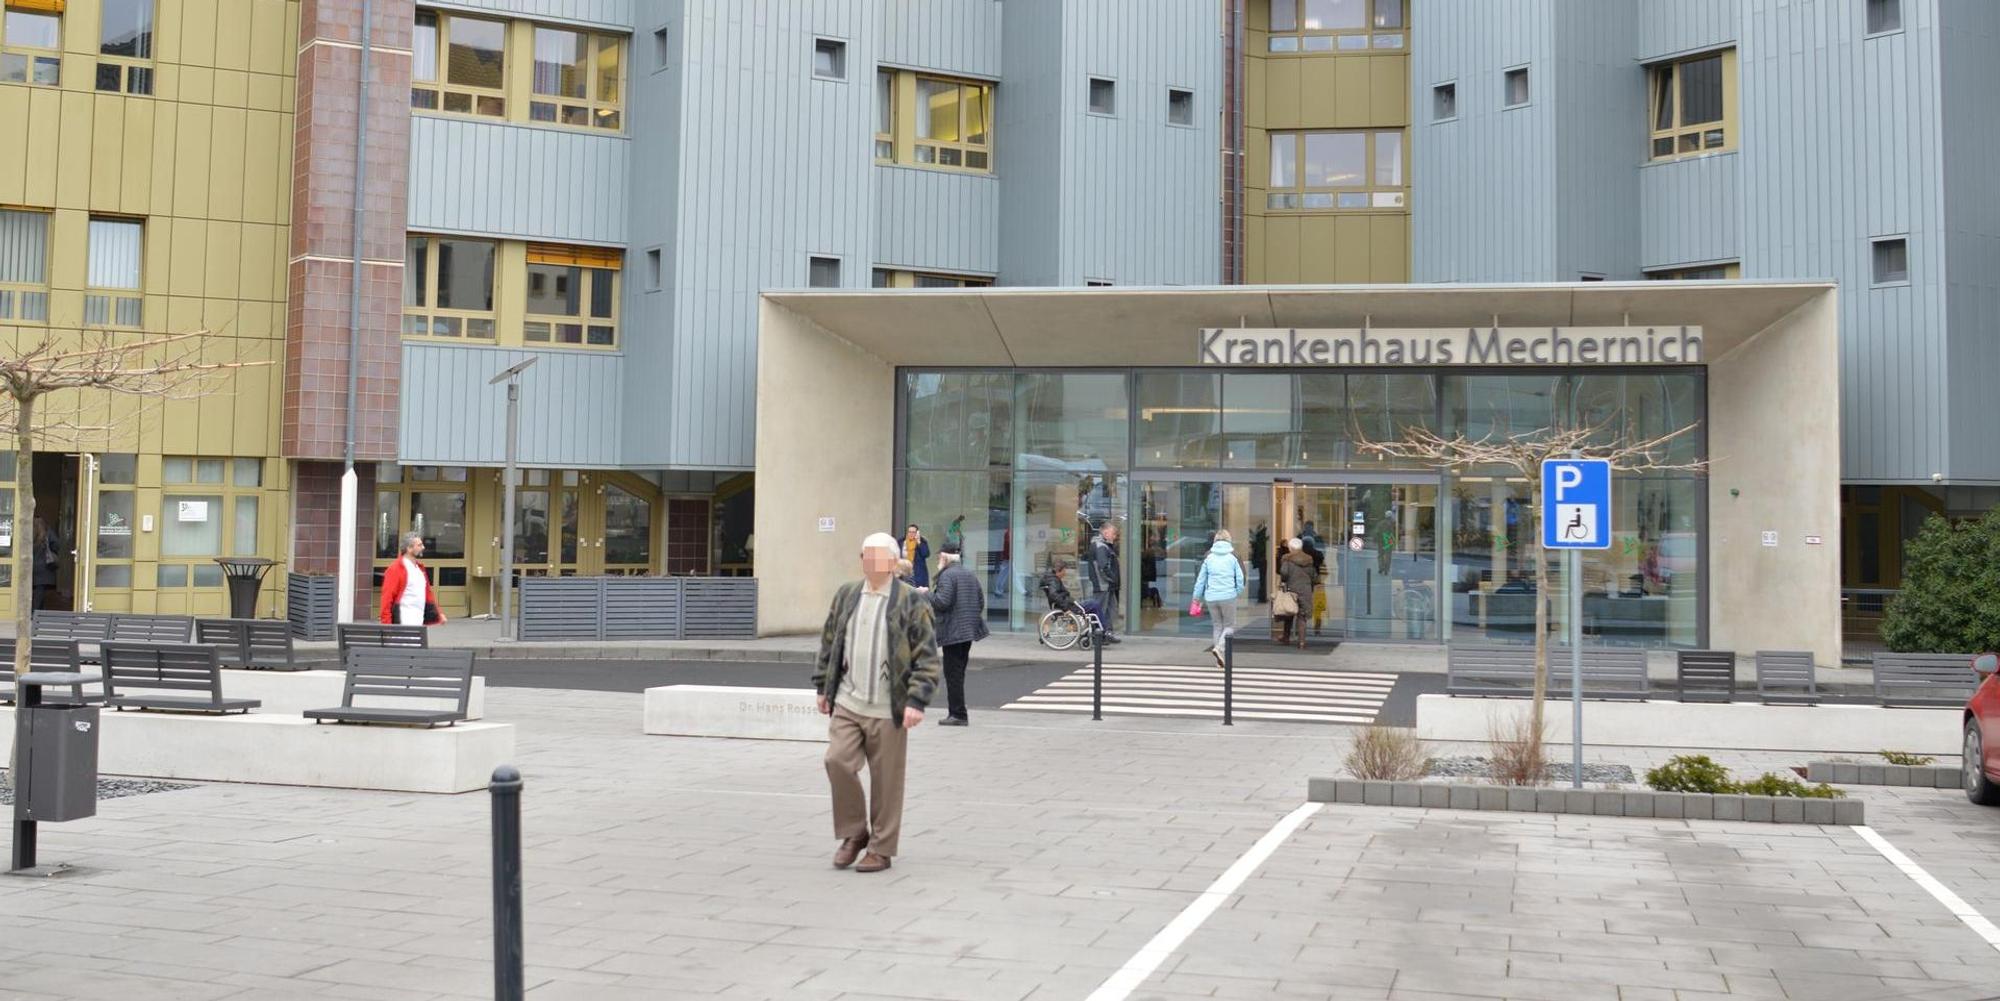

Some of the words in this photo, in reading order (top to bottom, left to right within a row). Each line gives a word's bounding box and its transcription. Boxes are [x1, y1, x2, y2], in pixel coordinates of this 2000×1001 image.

[1199, 328, 1453, 364] Krankenhaus
[1465, 326, 1703, 364] Mechernich
[1555, 465, 1582, 501] P
[756, 701, 785, 713] Hans
